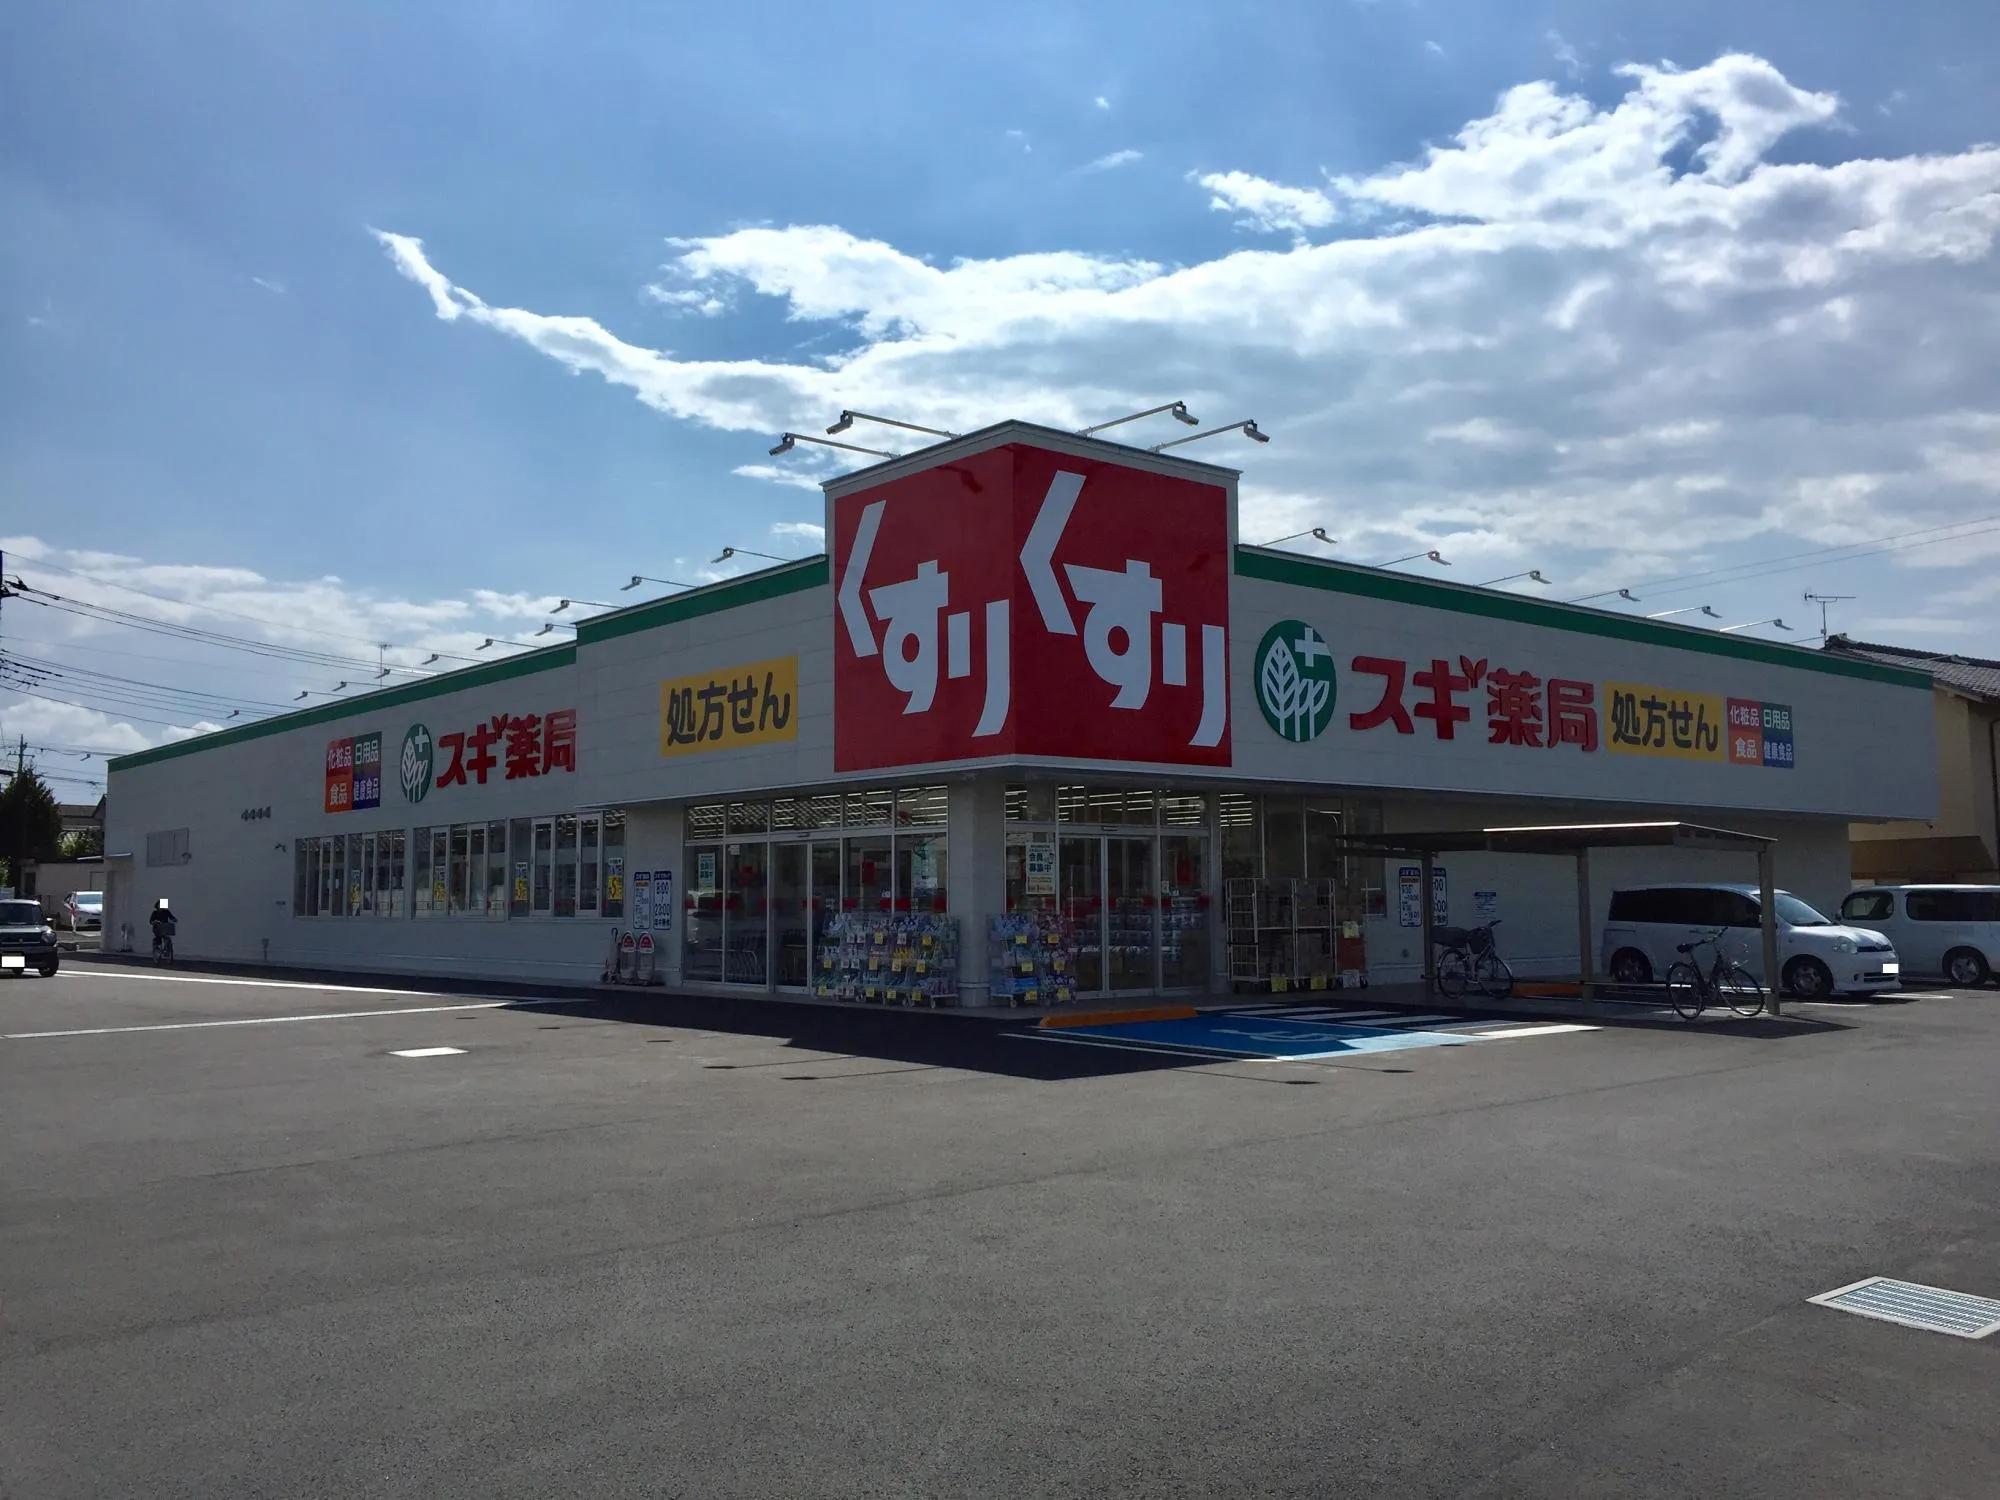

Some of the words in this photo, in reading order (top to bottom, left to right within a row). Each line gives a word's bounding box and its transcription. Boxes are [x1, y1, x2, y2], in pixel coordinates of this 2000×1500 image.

[838, 500, 1010, 737] くすり
[1019, 470, 1227, 747] くすり
[667, 672, 791, 746] 処方せん
[1349, 655, 1598, 752] スギ薬局
[1611, 690, 1719, 752] 処方せん
[1729, 705, 1760, 727] 化粧品
[1764, 709, 1791, 731] 日用品
[328, 747, 352, 770] 化粧品
[355, 739, 379, 765] 日用品
[436, 709, 577, 788] スギ薬局
[1735, 737, 1758, 759] 食品
[1764, 741, 1793, 761] 健康食品
[330, 783, 348, 806] 食品
[353, 778, 379, 801] 健康食品
